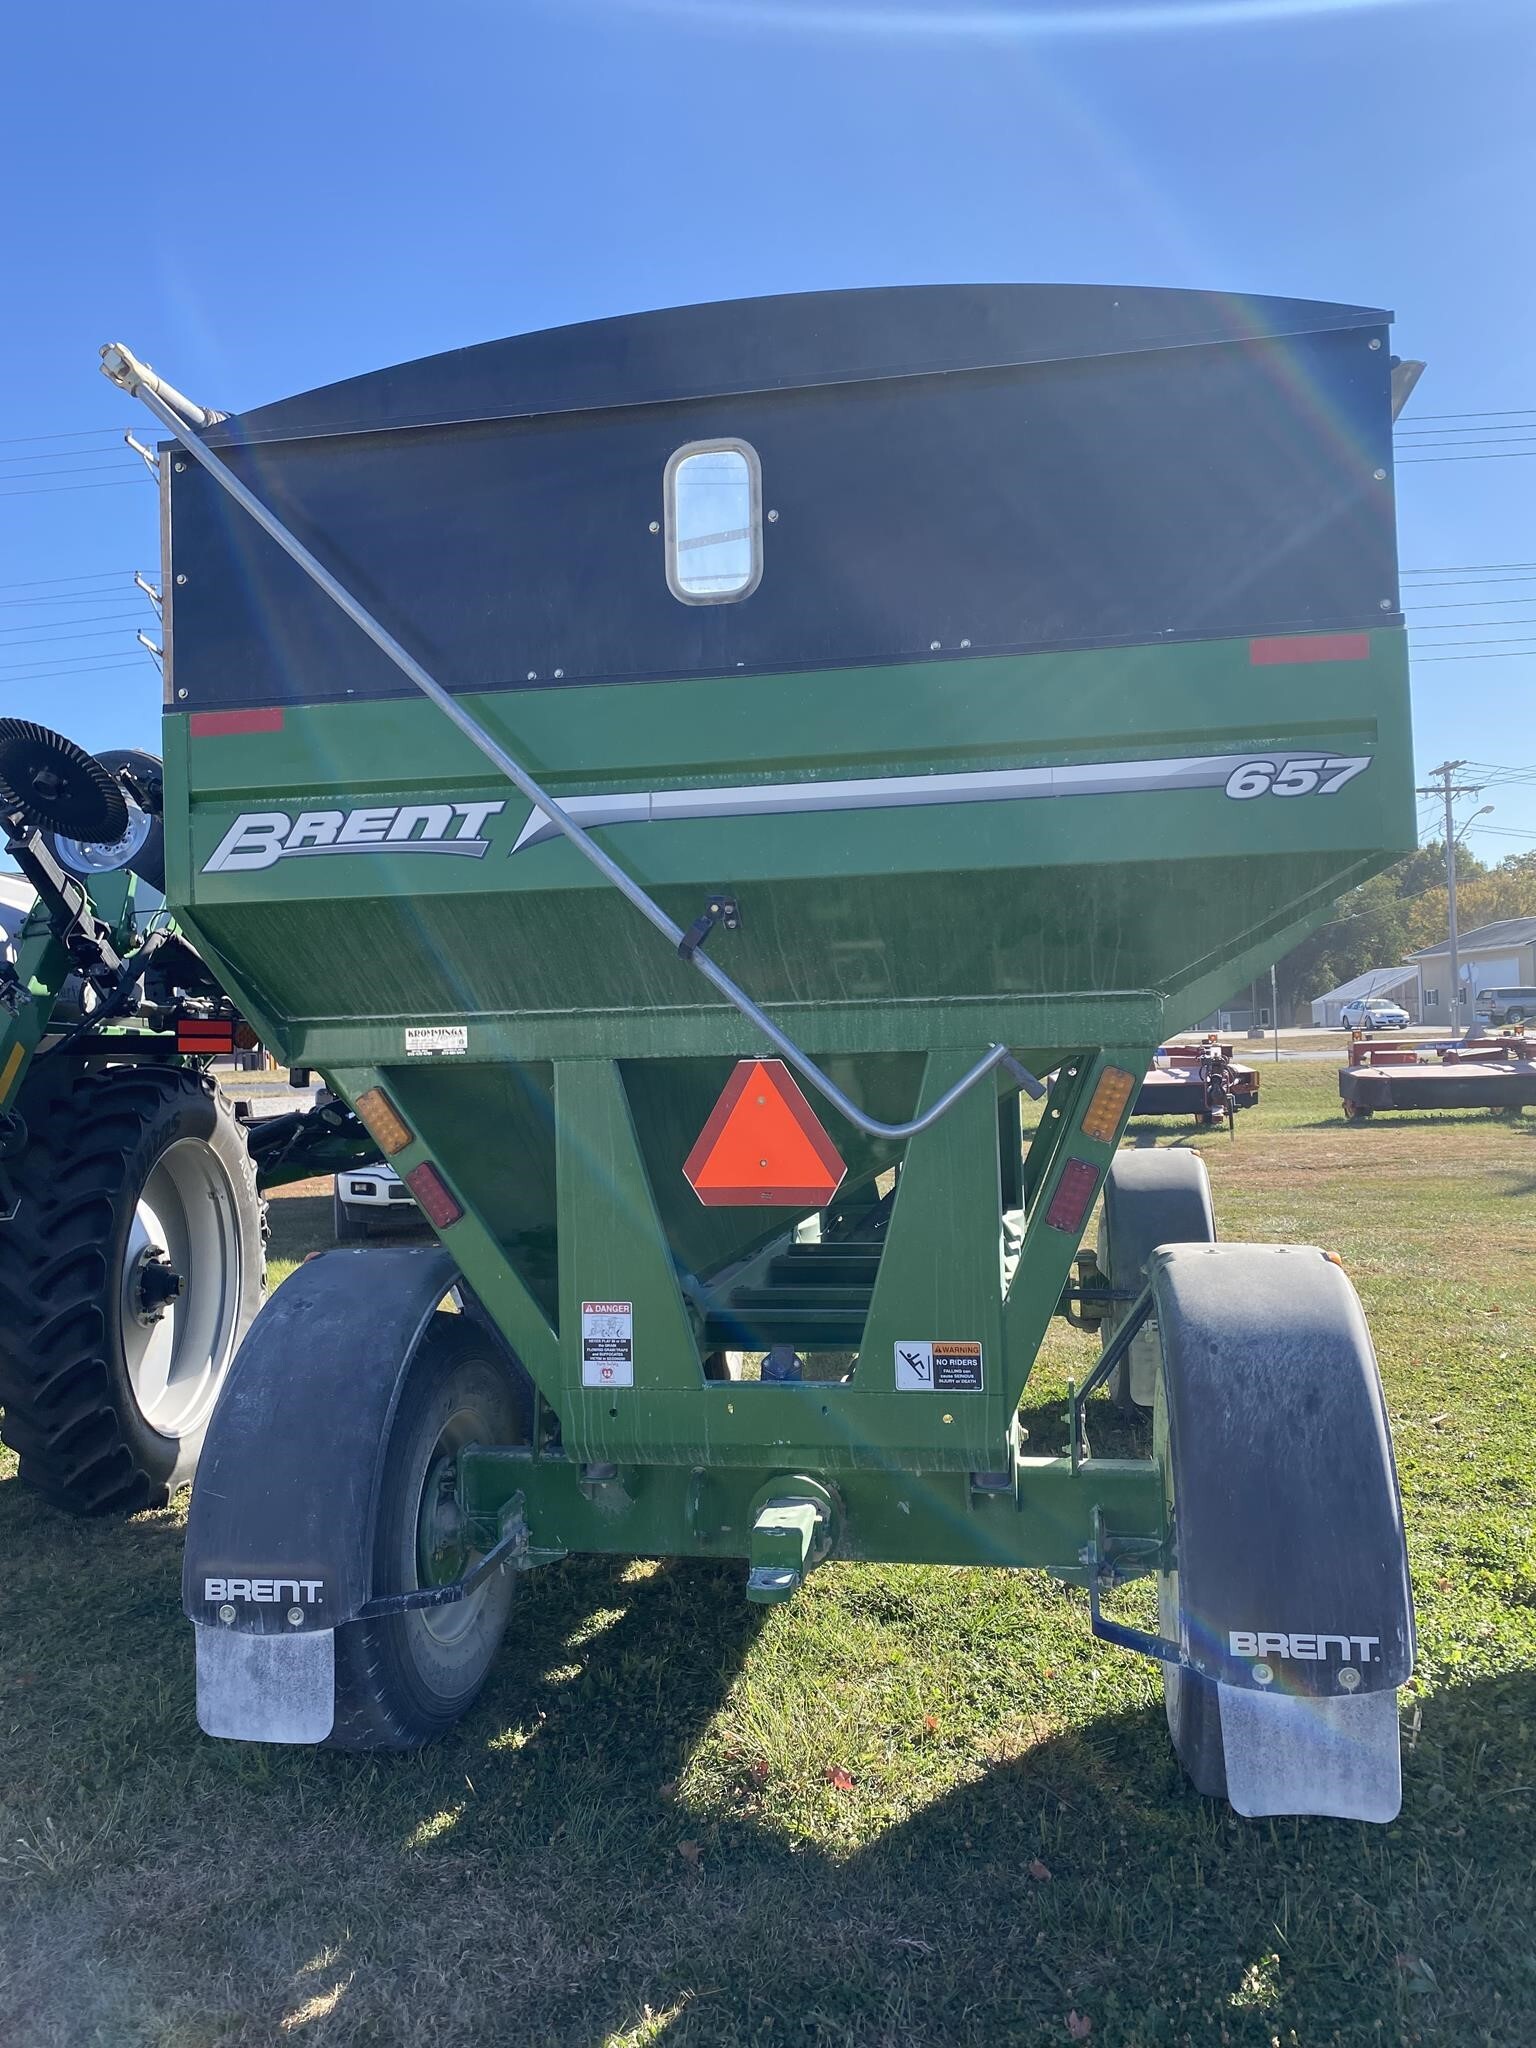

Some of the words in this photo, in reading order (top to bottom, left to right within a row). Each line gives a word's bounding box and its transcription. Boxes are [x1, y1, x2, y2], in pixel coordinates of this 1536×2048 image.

[1225, 755, 1373, 799] 657
[200, 800, 506, 873] BRENT
[595, 1304, 630, 1313] DANGER
[942, 1346, 979, 1354] WARNING
[936, 1358, 948, 1366] NO
[949, 1358, 978, 1366] RIDERS
